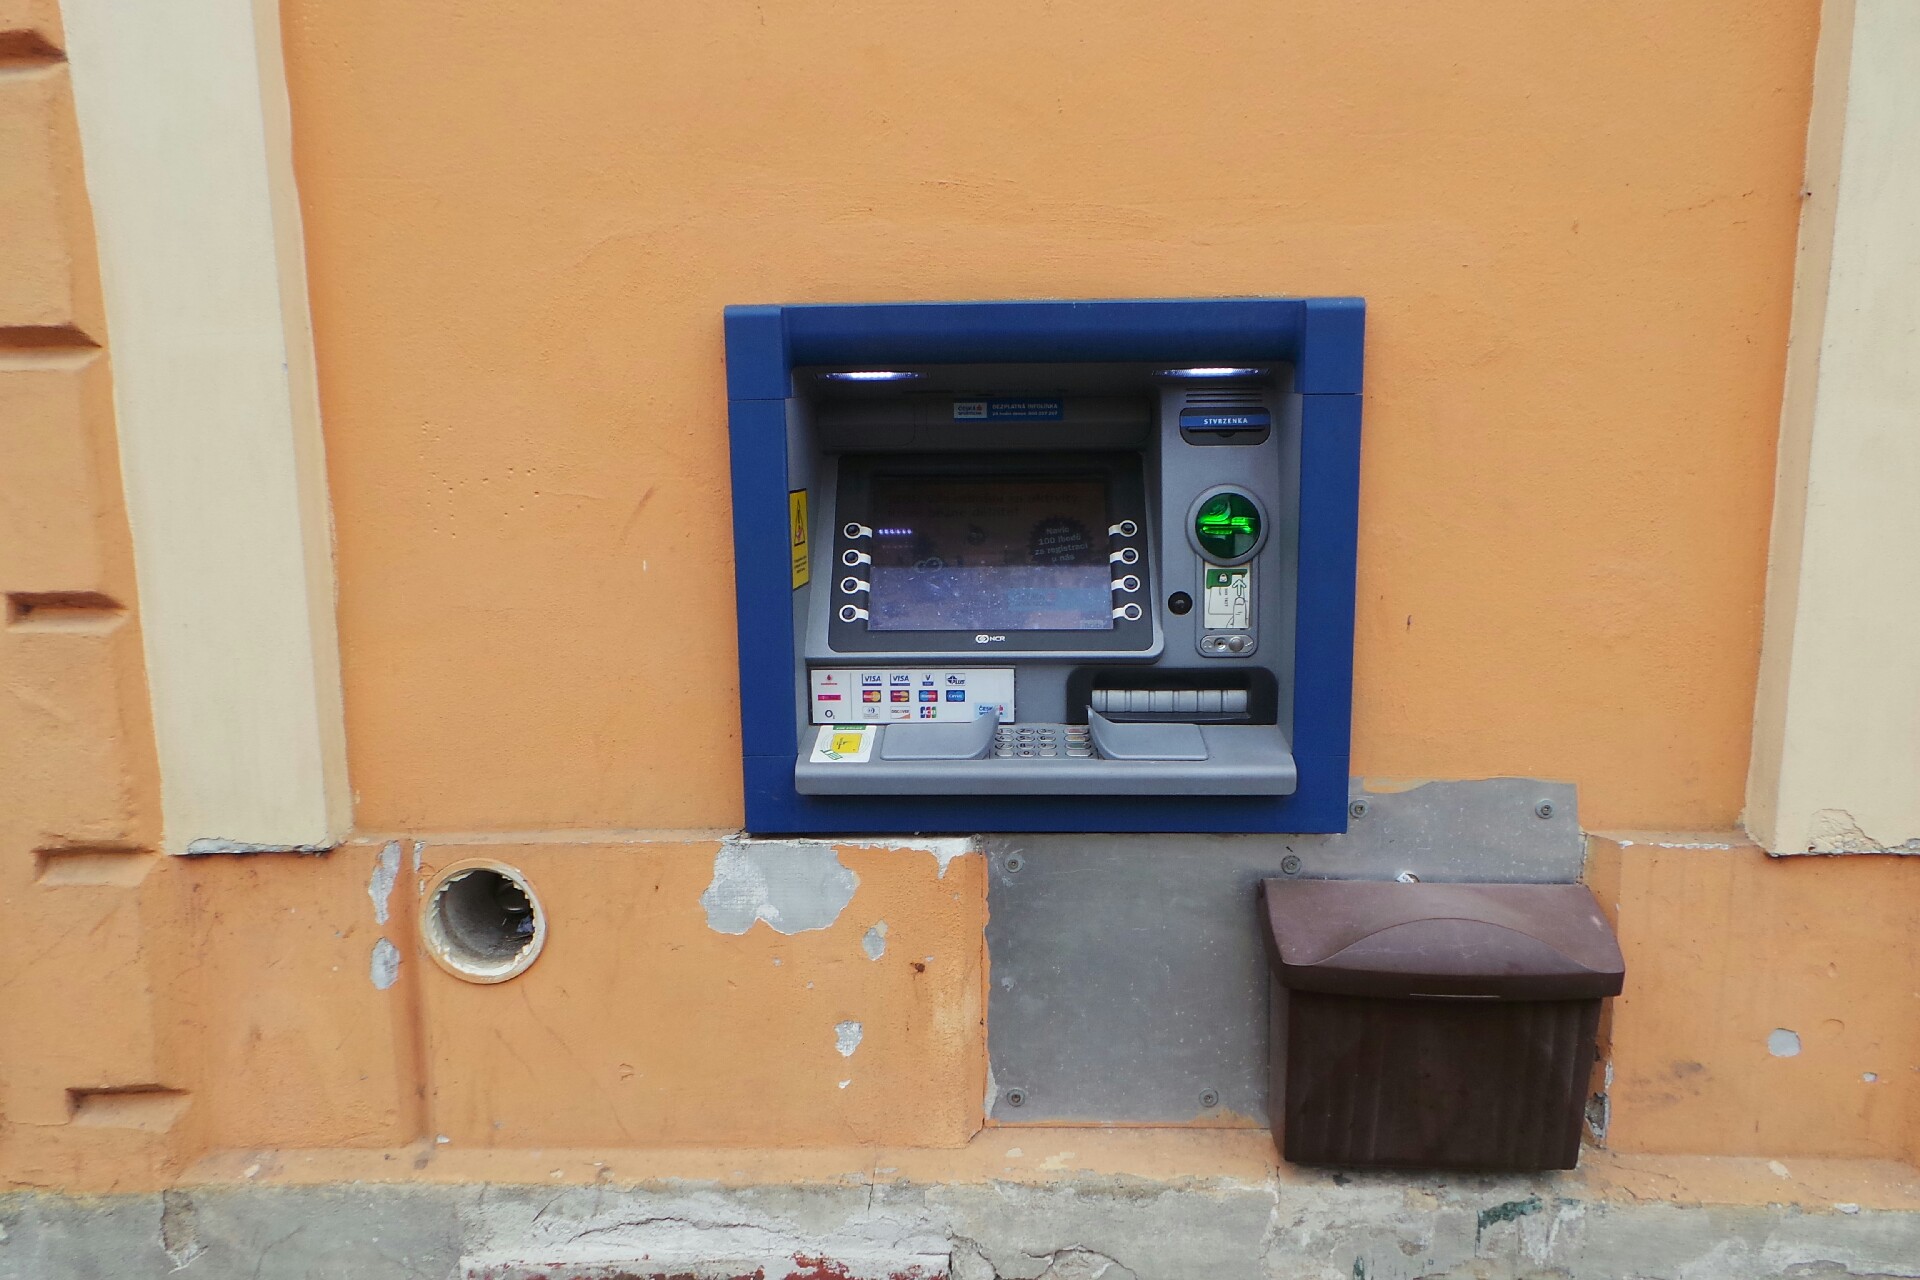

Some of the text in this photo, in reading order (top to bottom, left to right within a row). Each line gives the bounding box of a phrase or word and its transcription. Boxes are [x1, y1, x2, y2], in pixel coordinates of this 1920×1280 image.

[1203, 417, 1249, 425] STVRZENKA
[1038, 537, 1056, 546] 100
[1047, 542, 1089, 554] registraci
